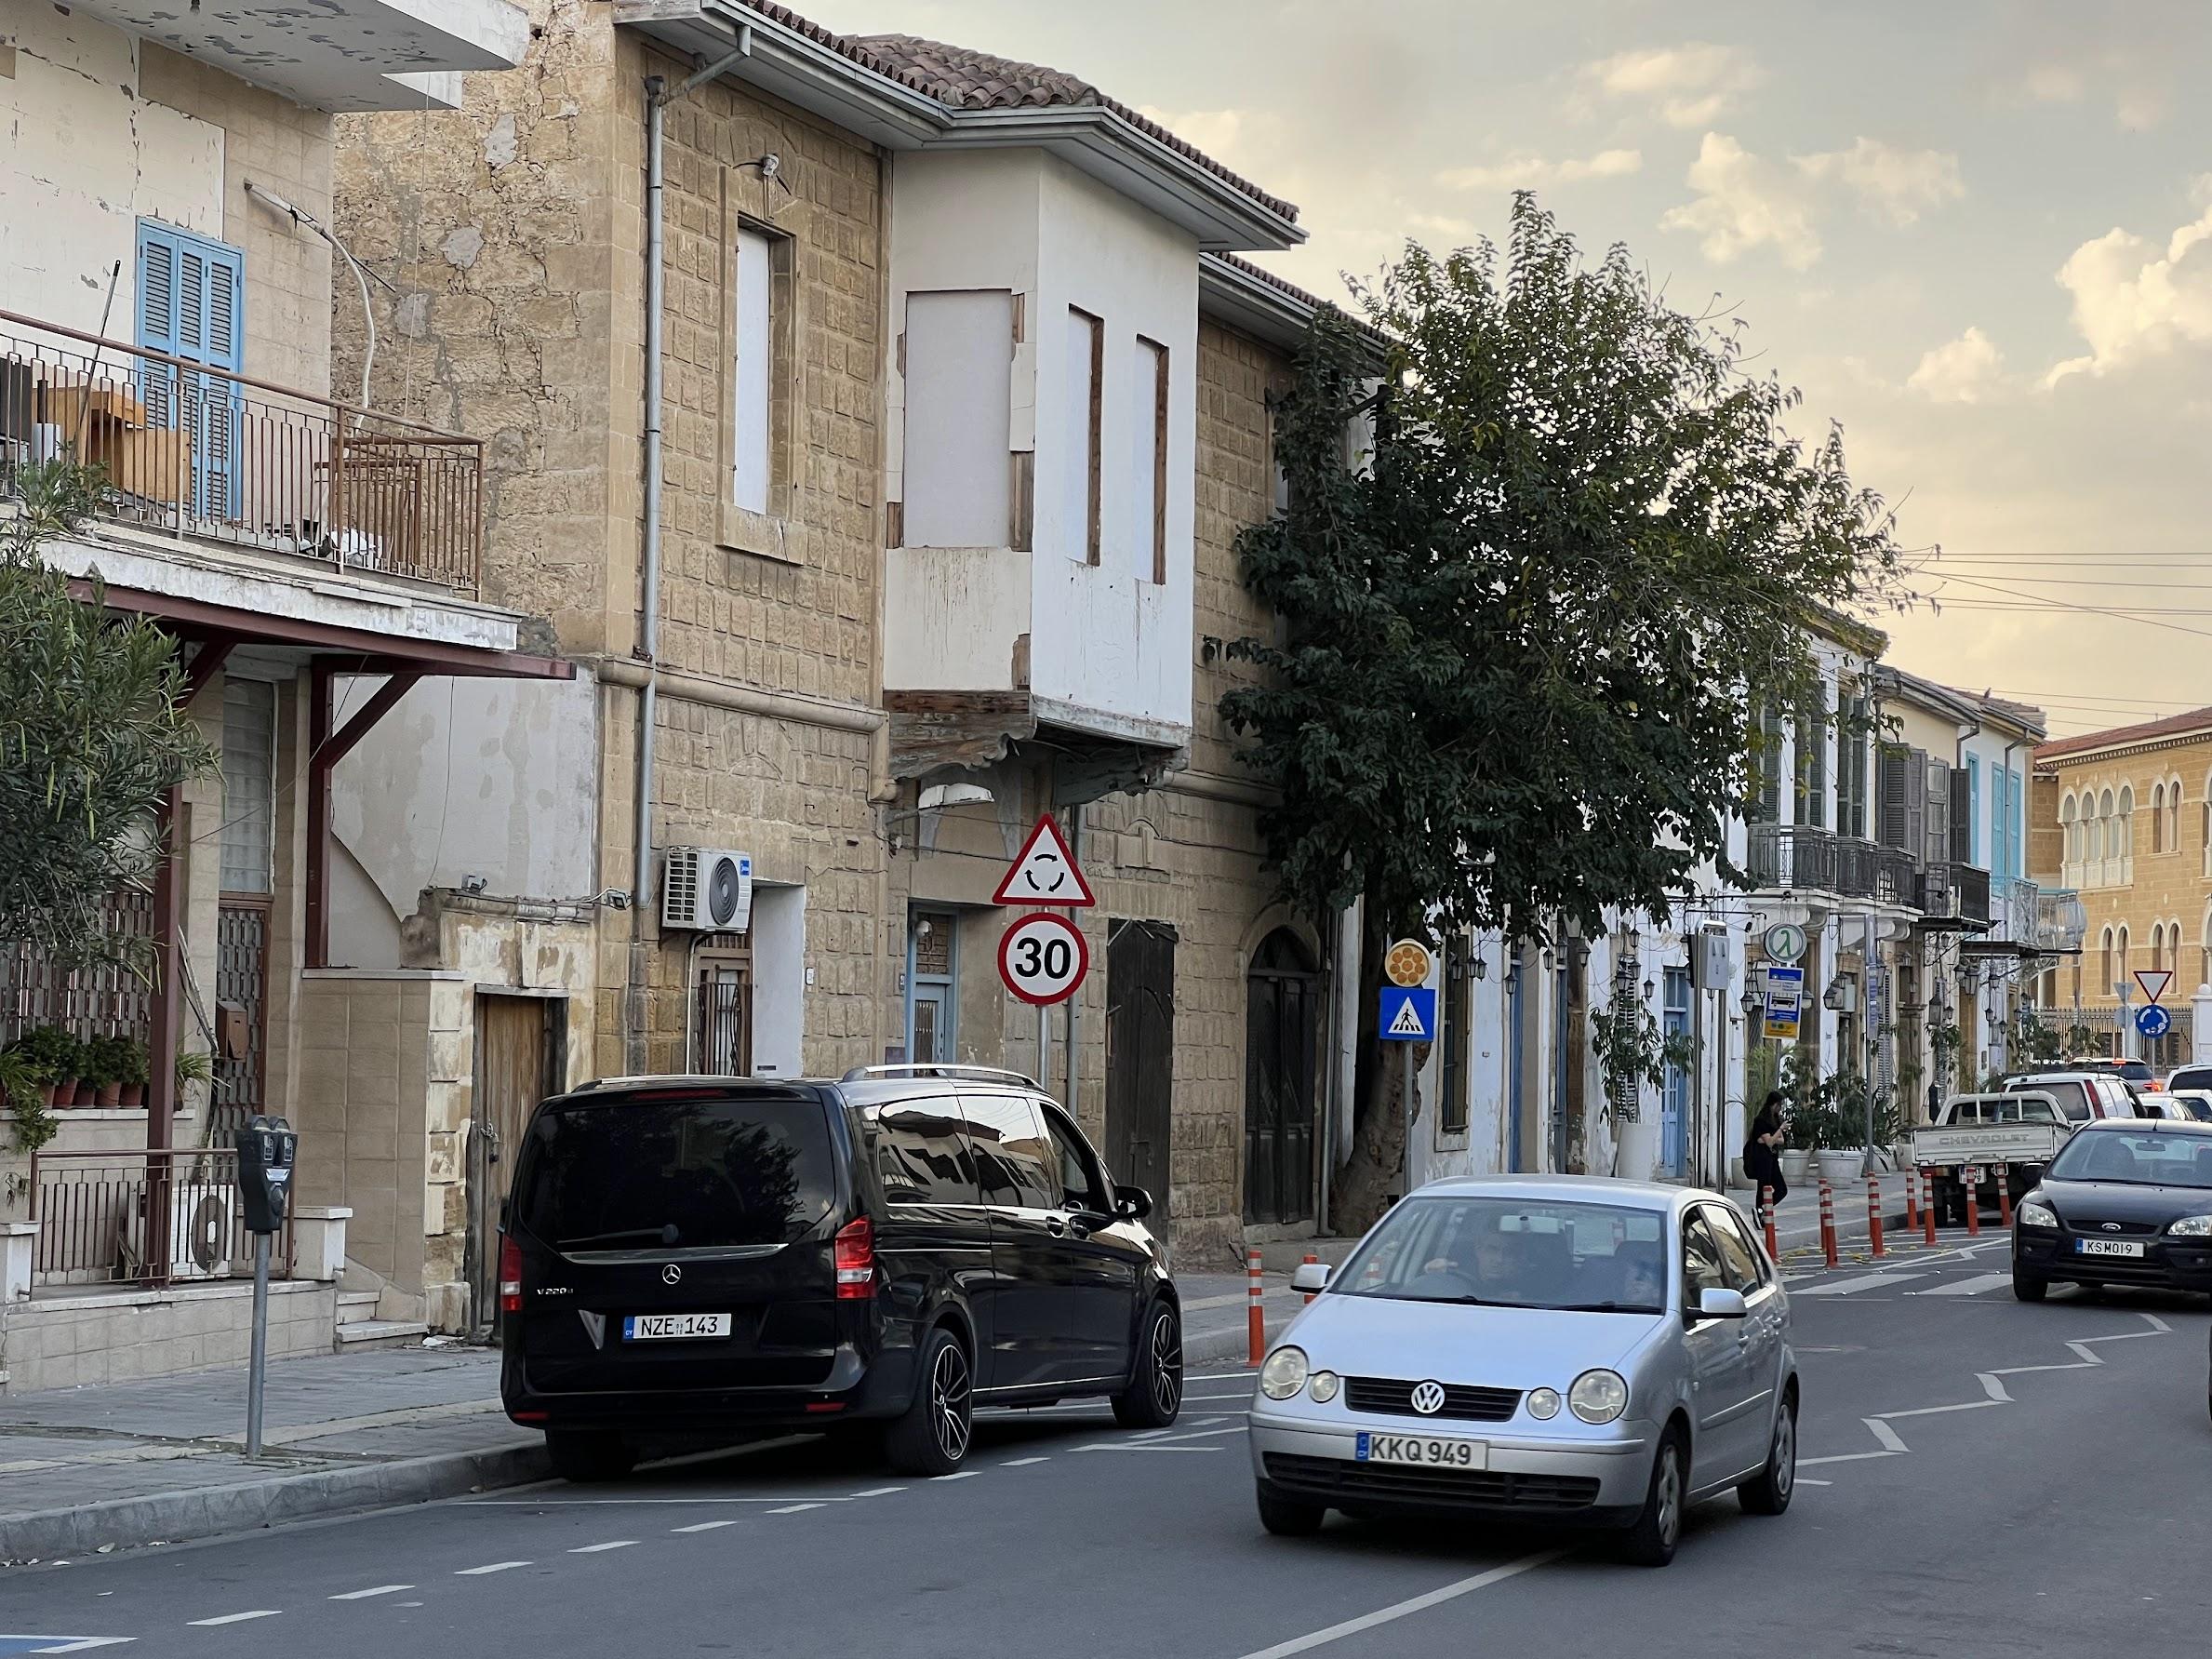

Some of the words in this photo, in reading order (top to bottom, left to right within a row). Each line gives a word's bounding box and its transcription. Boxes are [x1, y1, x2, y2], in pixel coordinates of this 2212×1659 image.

[1015, 937, 1072, 980] 30
[1939, 1133, 2030, 1145] CHEVROLET
[641, 1318, 675, 1336] NZE
[685, 1316, 718, 1334] 143
[1371, 1437, 1423, 1462] KKQ
[1428, 1441, 1472, 1465] 949
